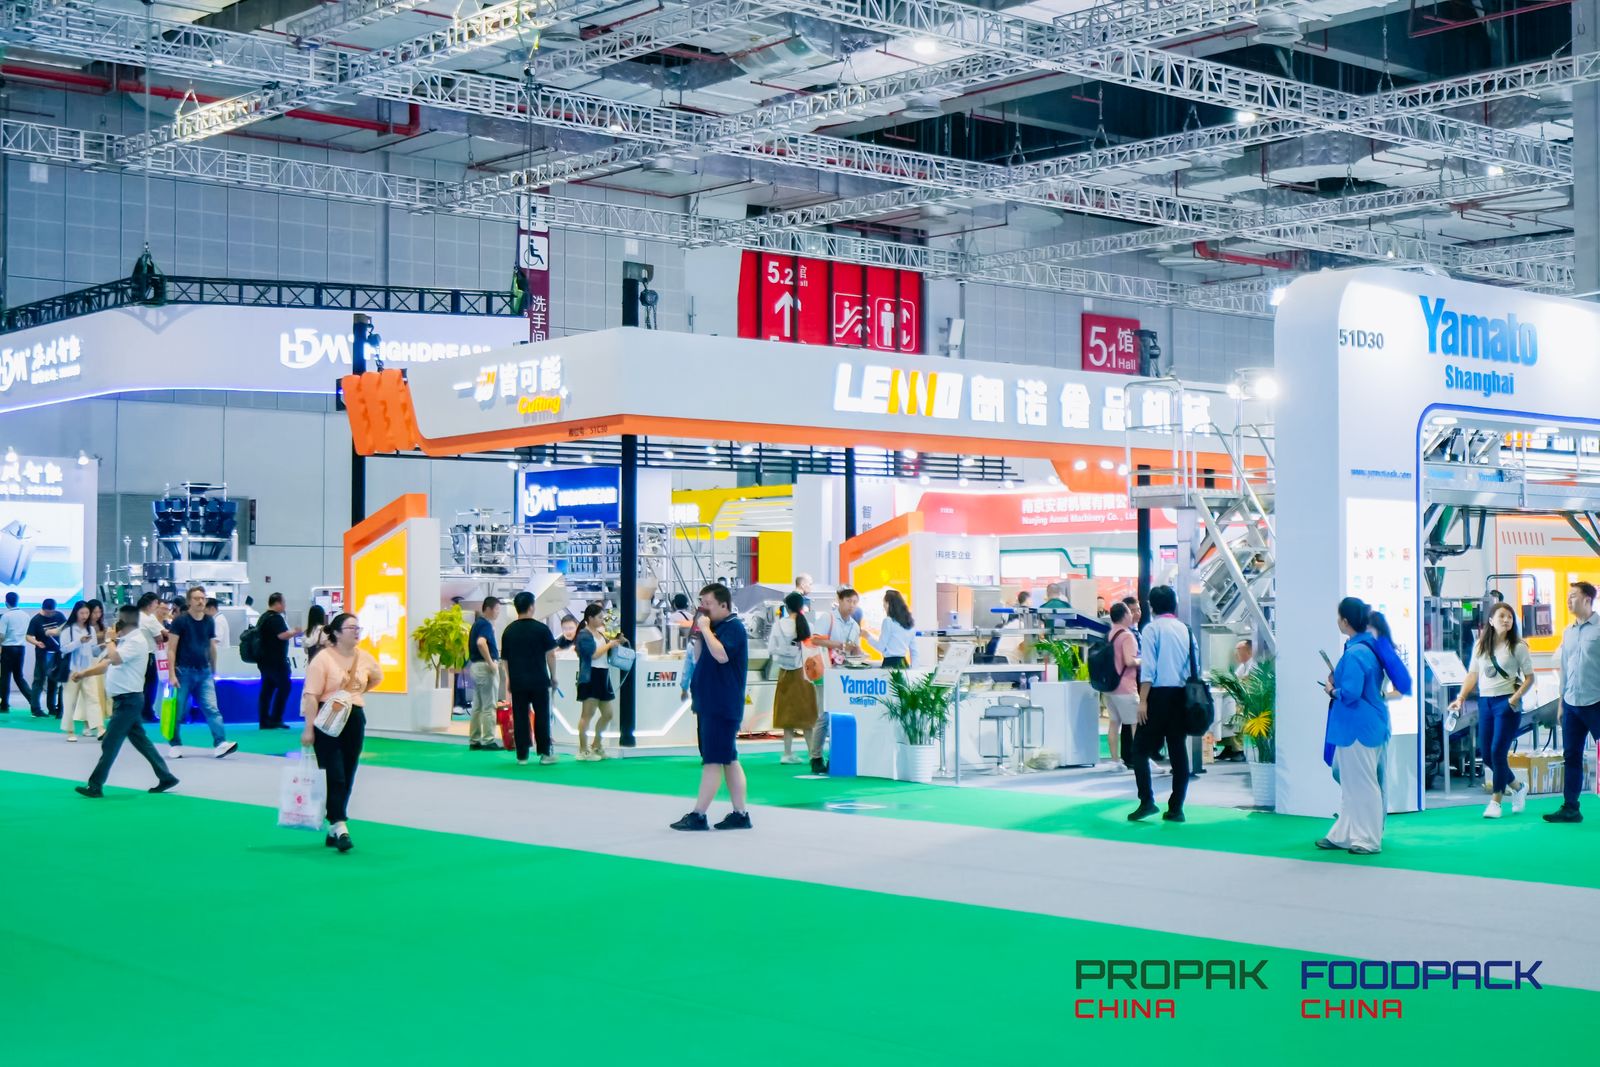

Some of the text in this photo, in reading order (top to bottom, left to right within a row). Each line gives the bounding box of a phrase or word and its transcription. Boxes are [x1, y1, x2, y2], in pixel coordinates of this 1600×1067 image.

[768, 261, 793, 285] 5.2
[532, 295, 547, 342] 洗手间
[1418, 295, 1538, 366] Yamato
[1089, 326, 1116, 368] 5.1
[1118, 328, 1134, 353] 馆
[1339, 328, 1384, 350] 51D30
[363, 341, 491, 362] HIGHDREA
[1118, 358, 1136, 370] Hall
[1445, 365, 1514, 397] Shanghai
[840, 674, 886, 695] Yamato
